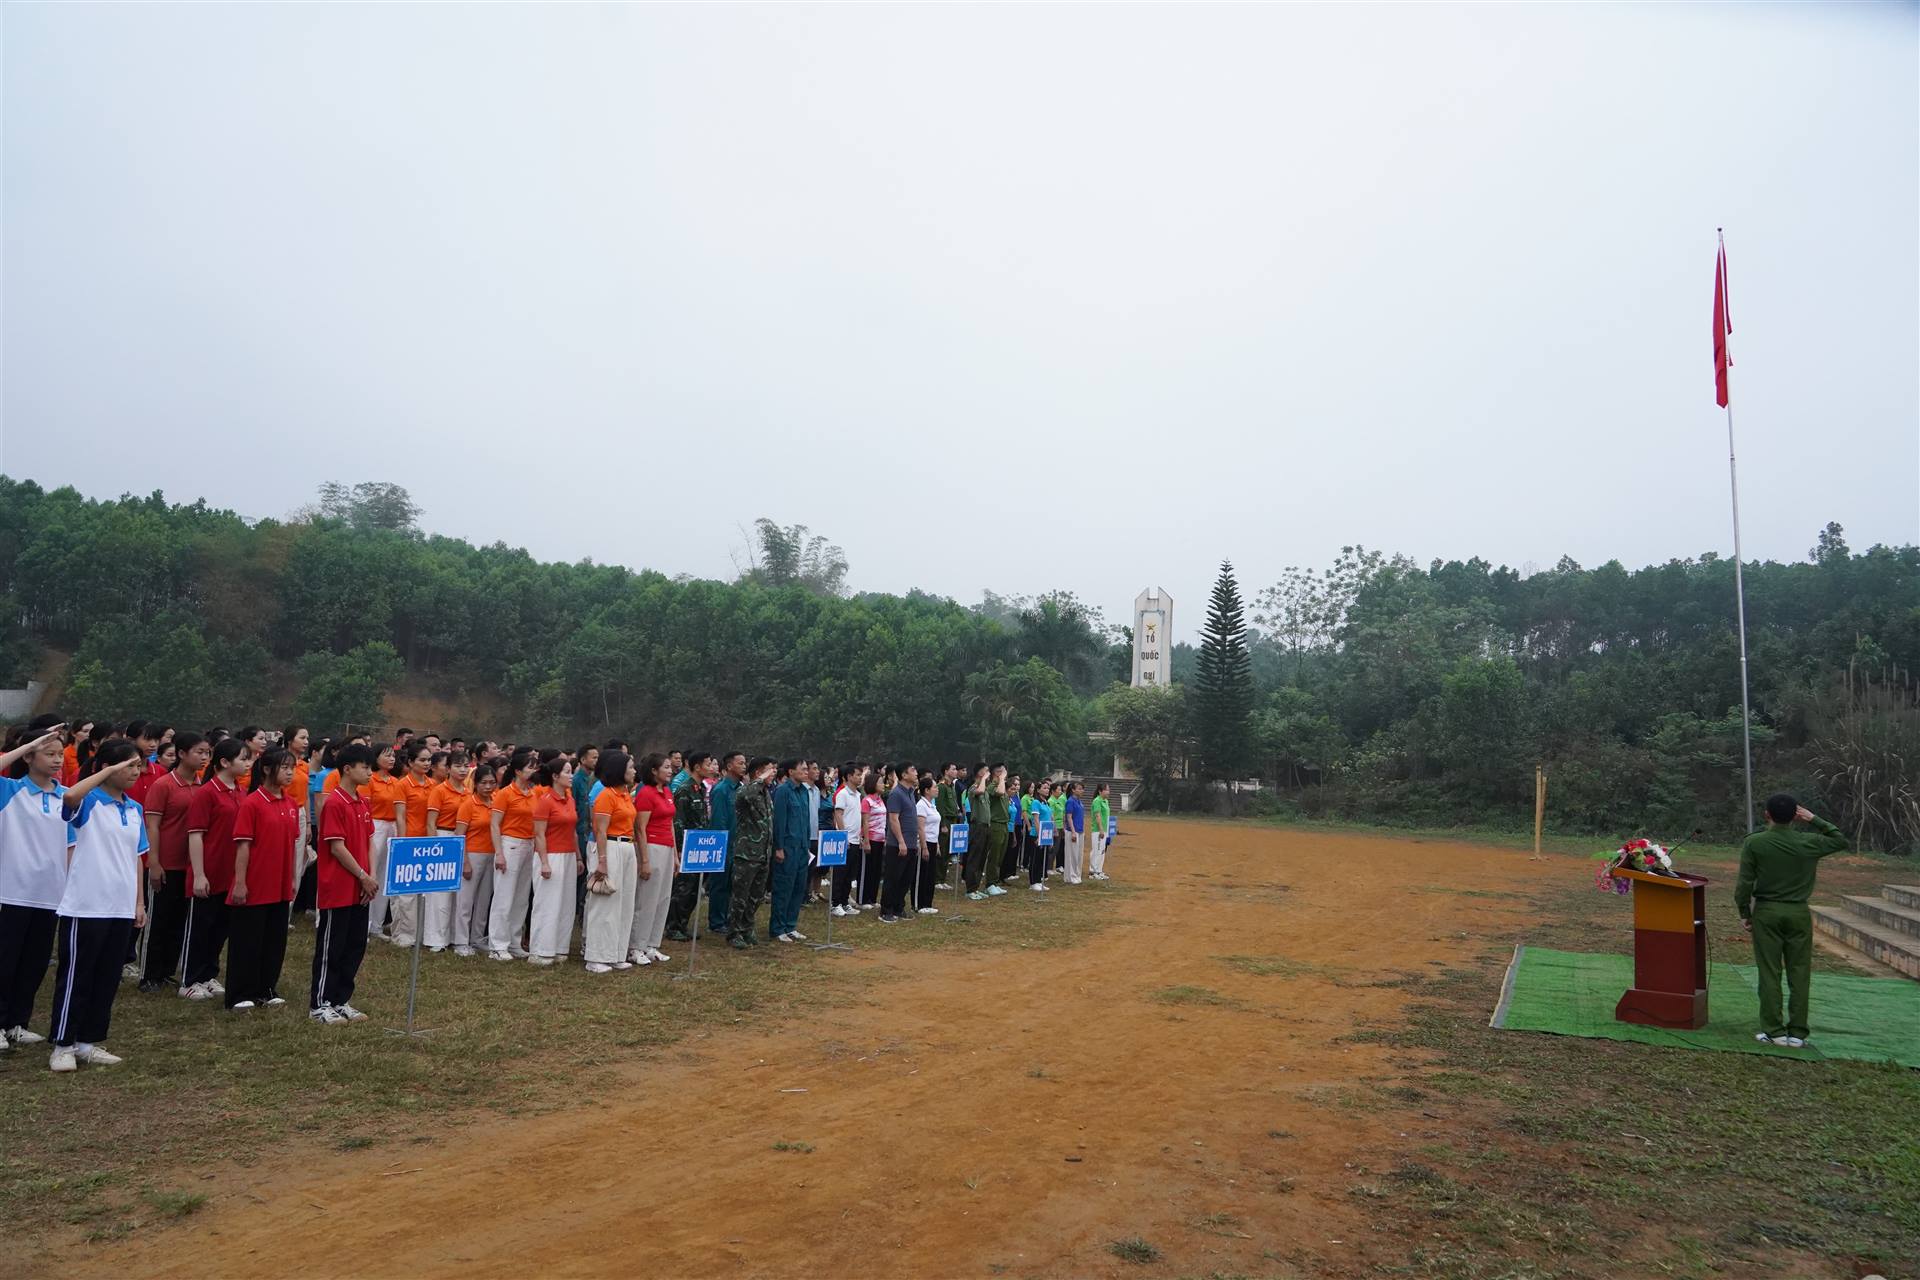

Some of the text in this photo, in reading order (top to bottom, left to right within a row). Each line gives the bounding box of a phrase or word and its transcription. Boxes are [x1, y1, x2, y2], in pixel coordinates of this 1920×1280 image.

[1141, 649, 1159, 660] QUỐC
[698, 835, 717, 845] KHỐI
[823, 838, 845, 857] QUÂN SỰ
[413, 842, 444, 857] KHỐI
[395, 862, 457, 887] HỌC SINH
